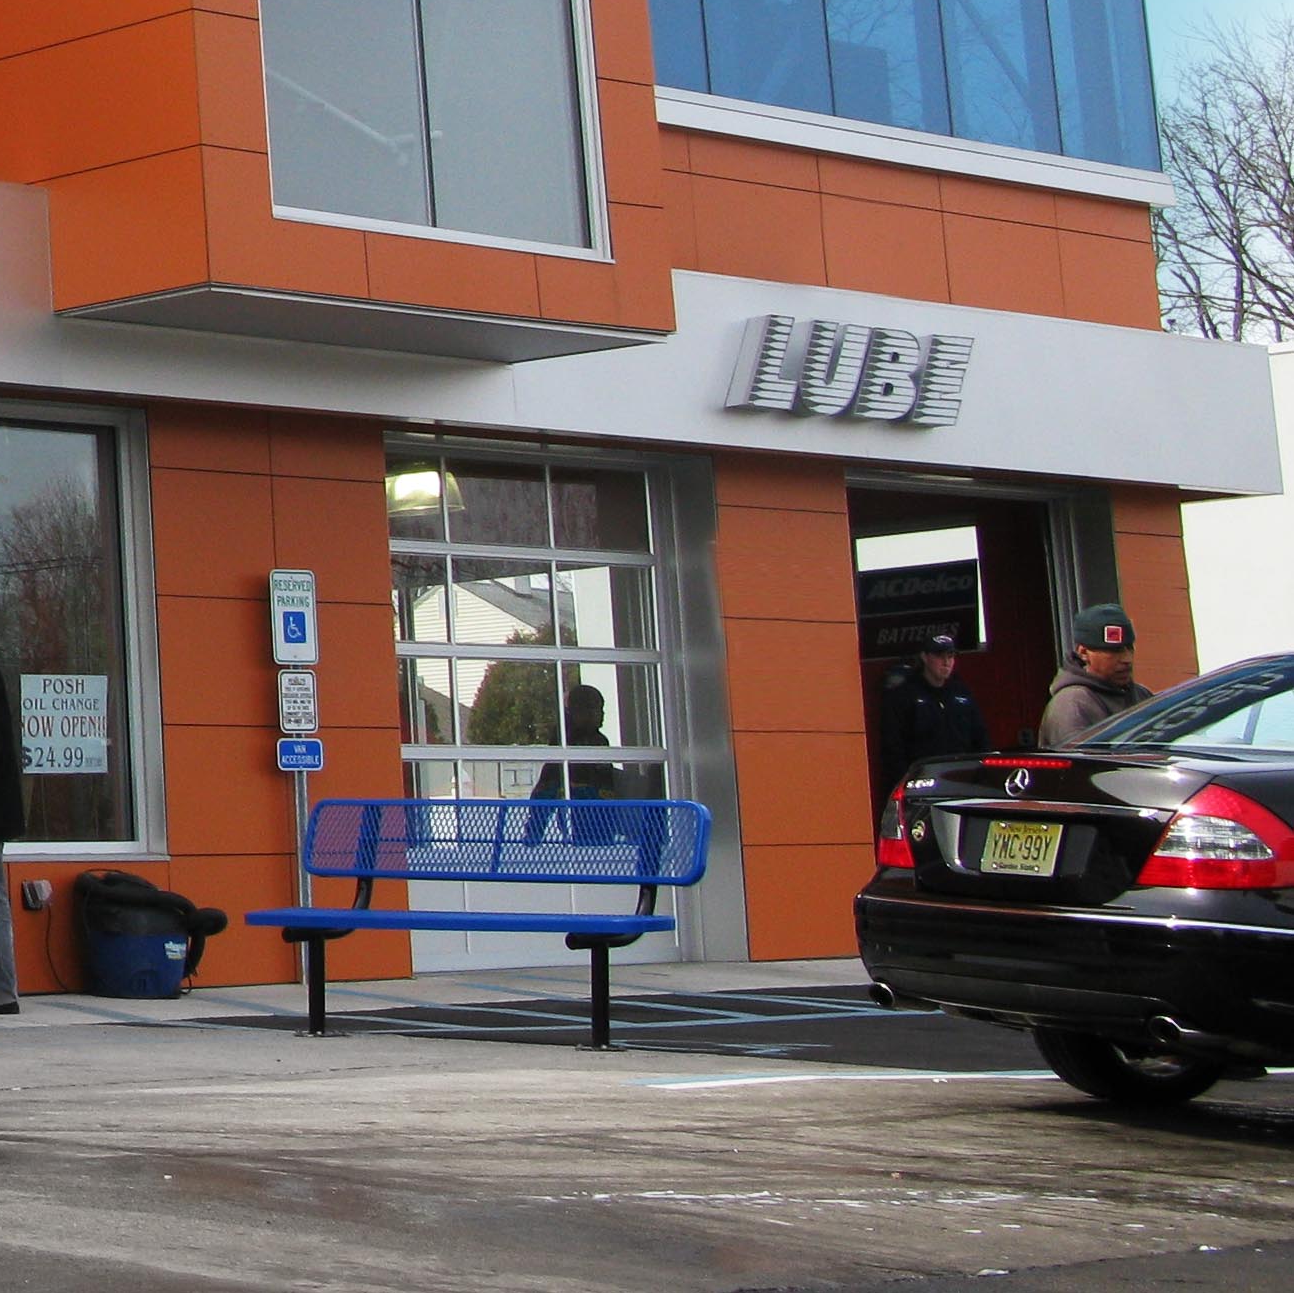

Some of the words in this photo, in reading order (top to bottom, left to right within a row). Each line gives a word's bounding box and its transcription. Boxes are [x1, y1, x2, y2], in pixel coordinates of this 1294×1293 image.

[724, 313, 975, 426] LUBE
[273, 579, 312, 592] RESERVED
[276, 595, 310, 608] PARKING
[42, 678, 85, 695] POSH
[22, 698, 46, 711] OIL
[52, 698, 100, 711] CHANGE
[293, 744, 307, 754] VAN
[281, 755, 320, 765] ACCESSIBLE
